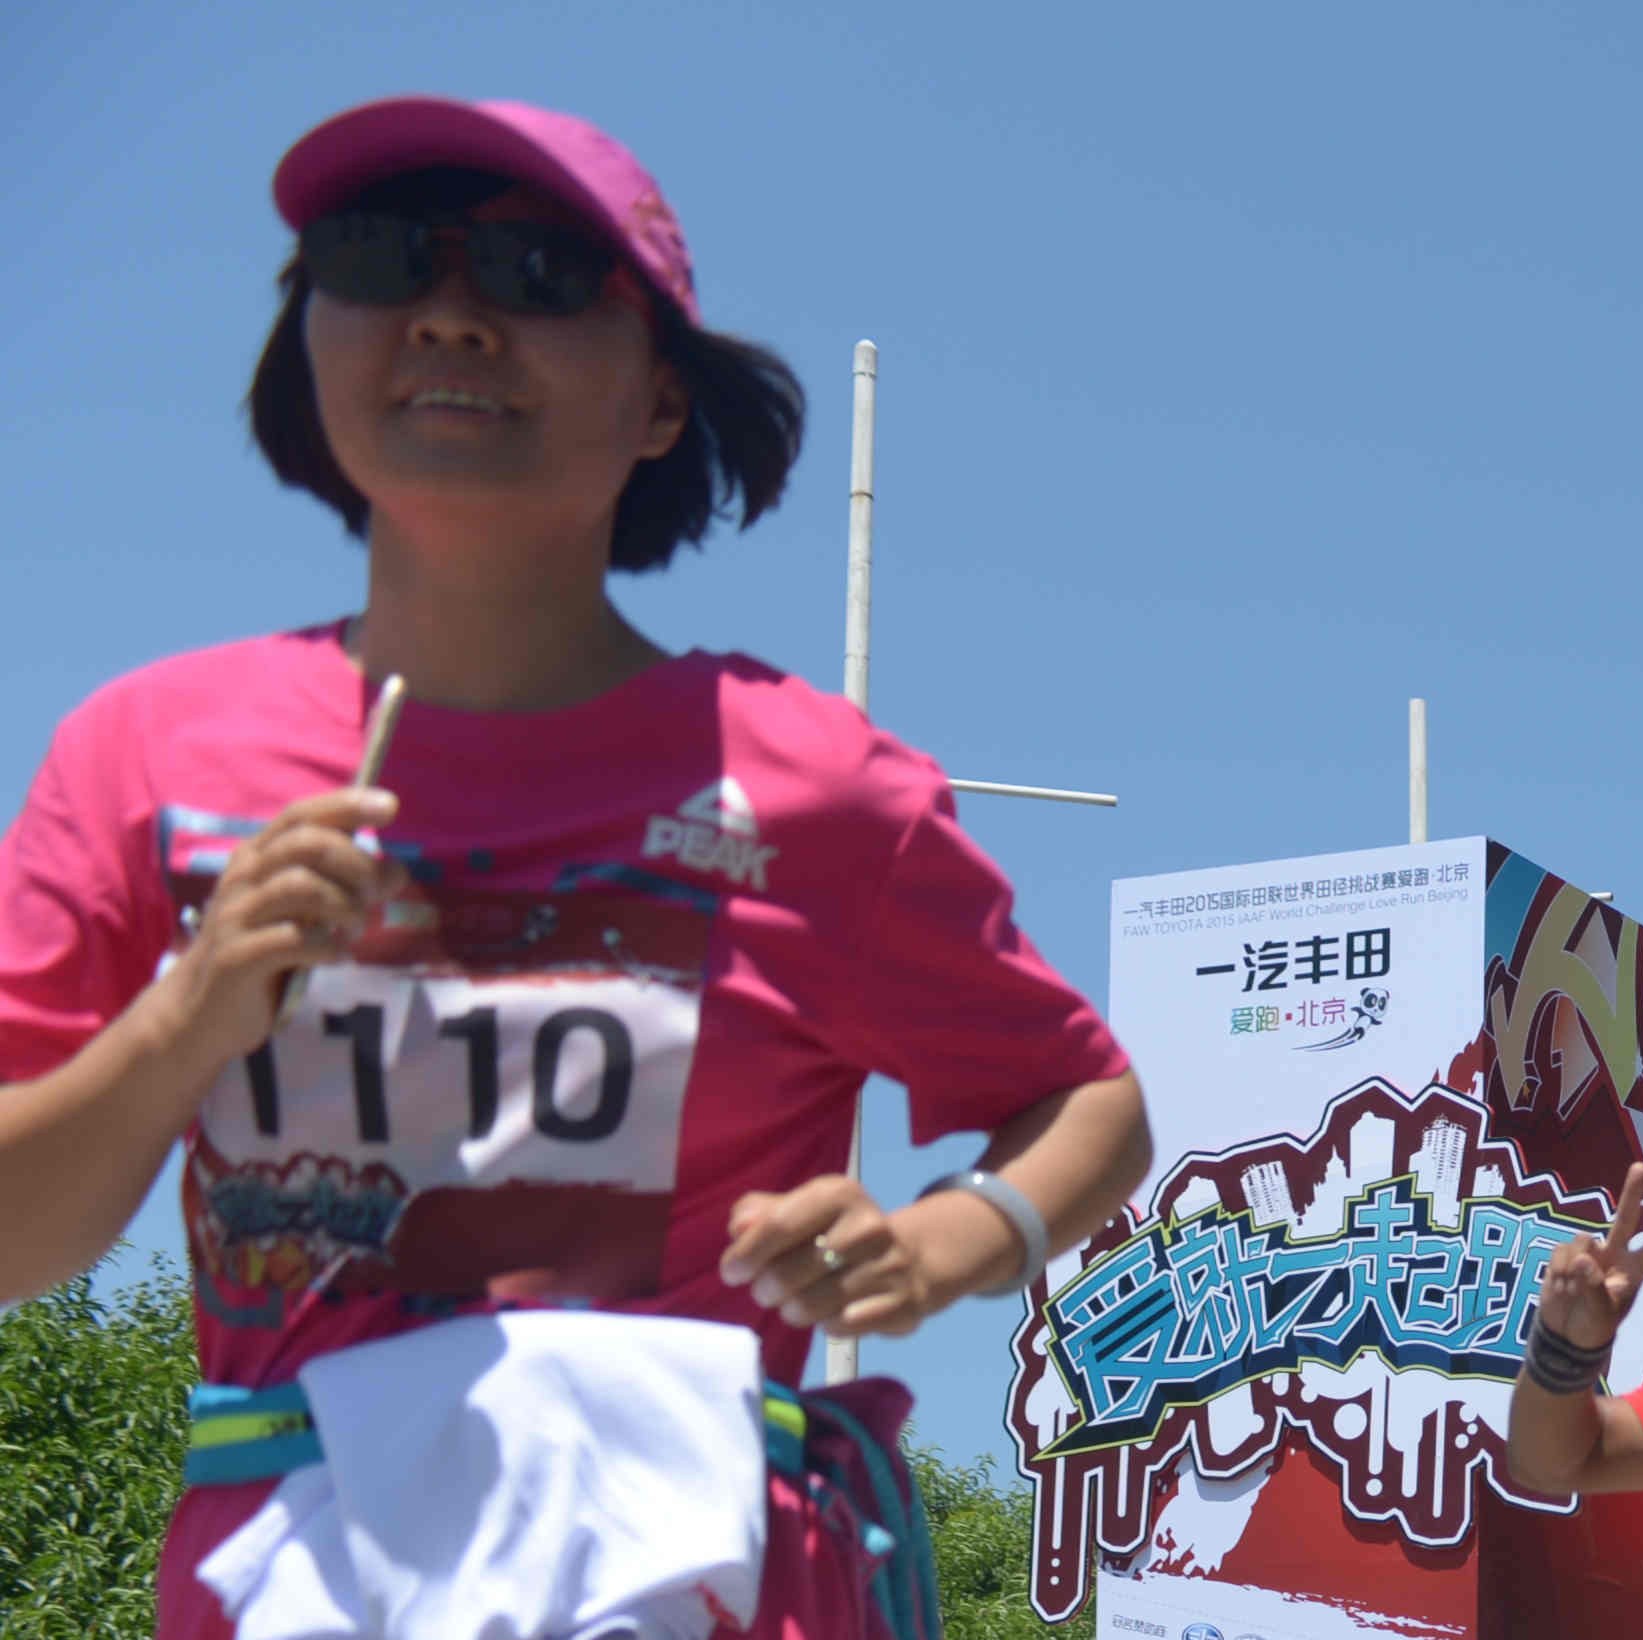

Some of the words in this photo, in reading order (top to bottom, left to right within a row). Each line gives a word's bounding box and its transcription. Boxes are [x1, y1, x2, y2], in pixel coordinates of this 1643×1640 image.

[641, 816, 777, 890] PEAK
[1123, 924, 1149, 937] FAW
[1153, 918, 1202, 935] TOYOTA
[1206, 913, 1235, 929] 2015
[1269, 905, 1303, 920] World
[1306, 899, 1366, 917] Challenge
[1369, 896, 1398, 910] Love
[1401, 892, 1425, 906] Run
[1428, 886, 1468, 902] Beijing
[1196, 927, 1391, 993] 一汽丰田
